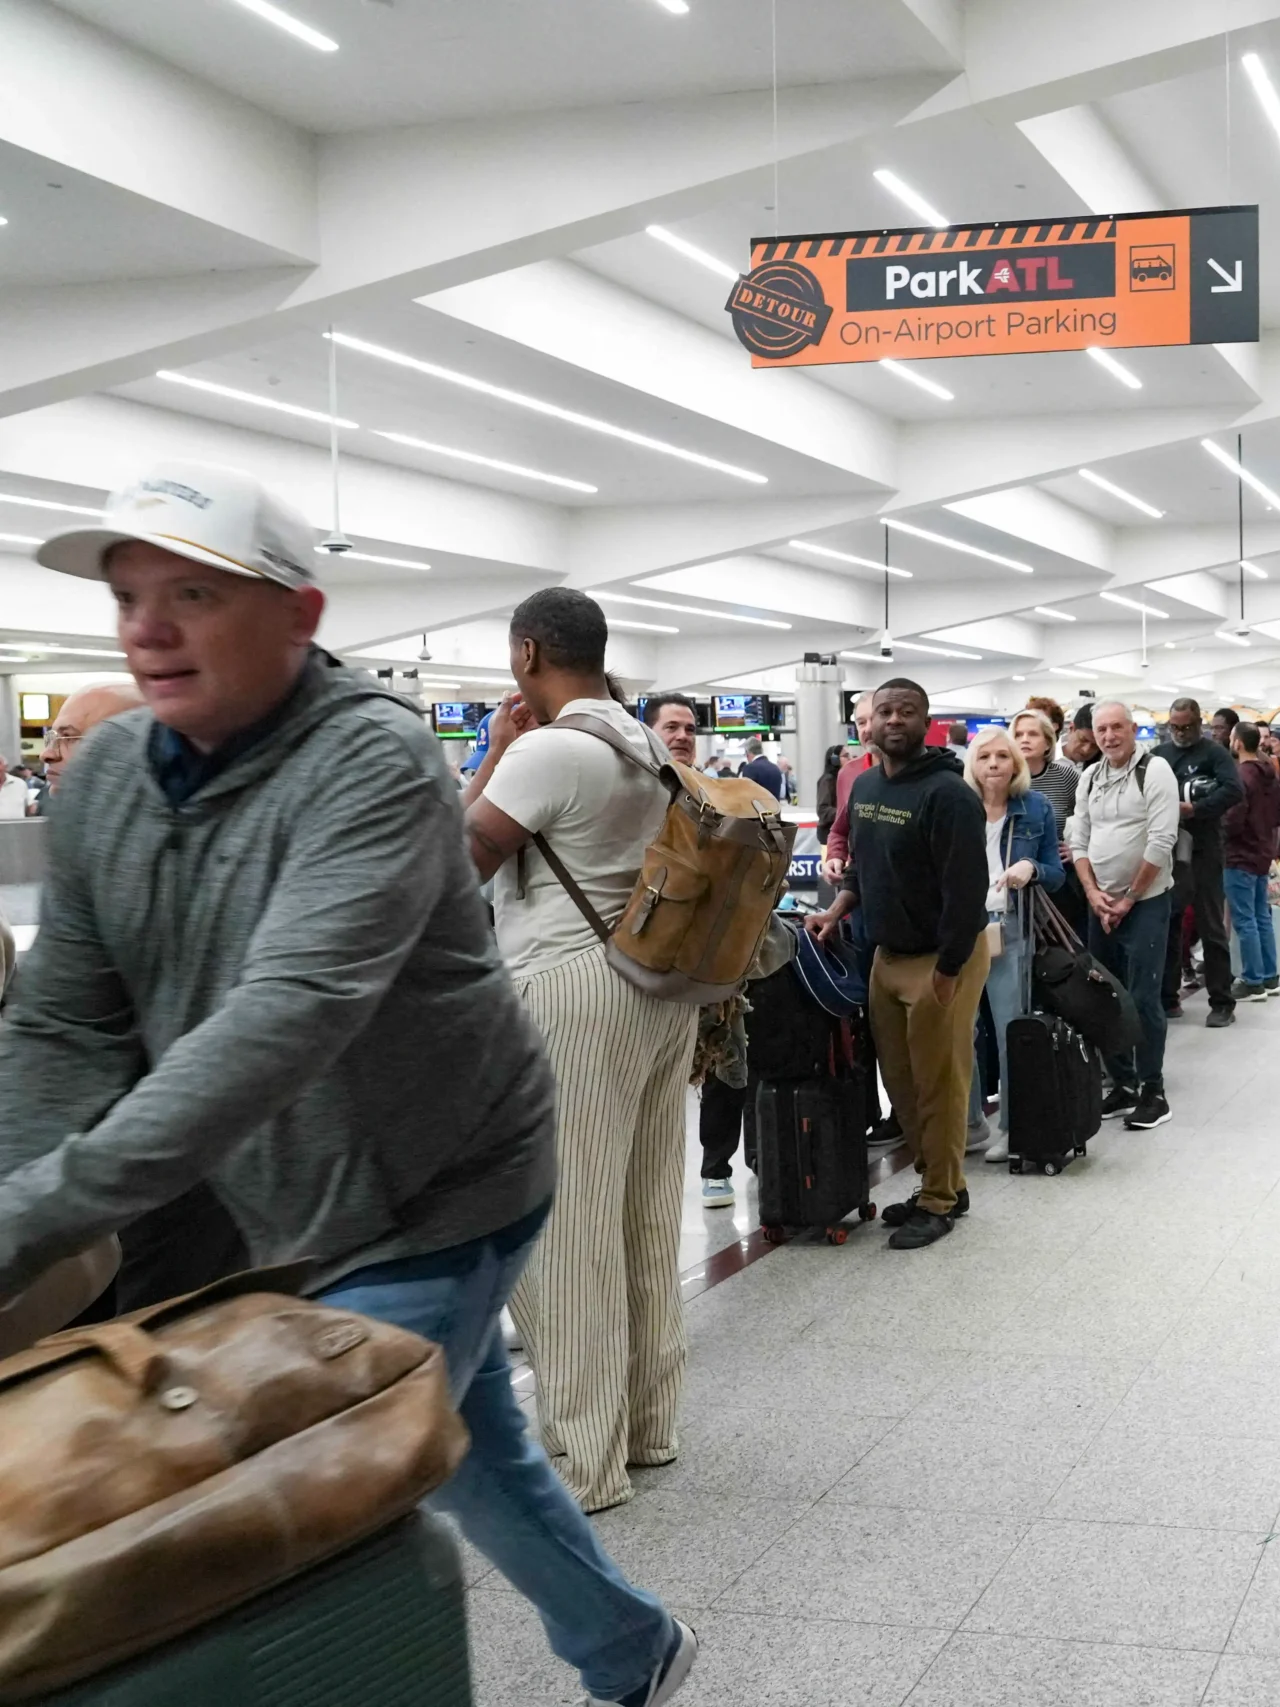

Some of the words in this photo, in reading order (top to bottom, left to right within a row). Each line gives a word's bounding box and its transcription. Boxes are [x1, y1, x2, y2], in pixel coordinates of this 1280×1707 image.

[739, 288, 817, 329] DETOUR
[839, 314, 997, 347] On-Airport
[1006, 308, 1118, 338] Parking
[854, 802, 875, 811] Georgia
[879, 805, 912, 818] Research
[858, 810, 873, 818] Tech
[878, 813, 905, 825] Institute
[786, 859, 814, 877] RST
